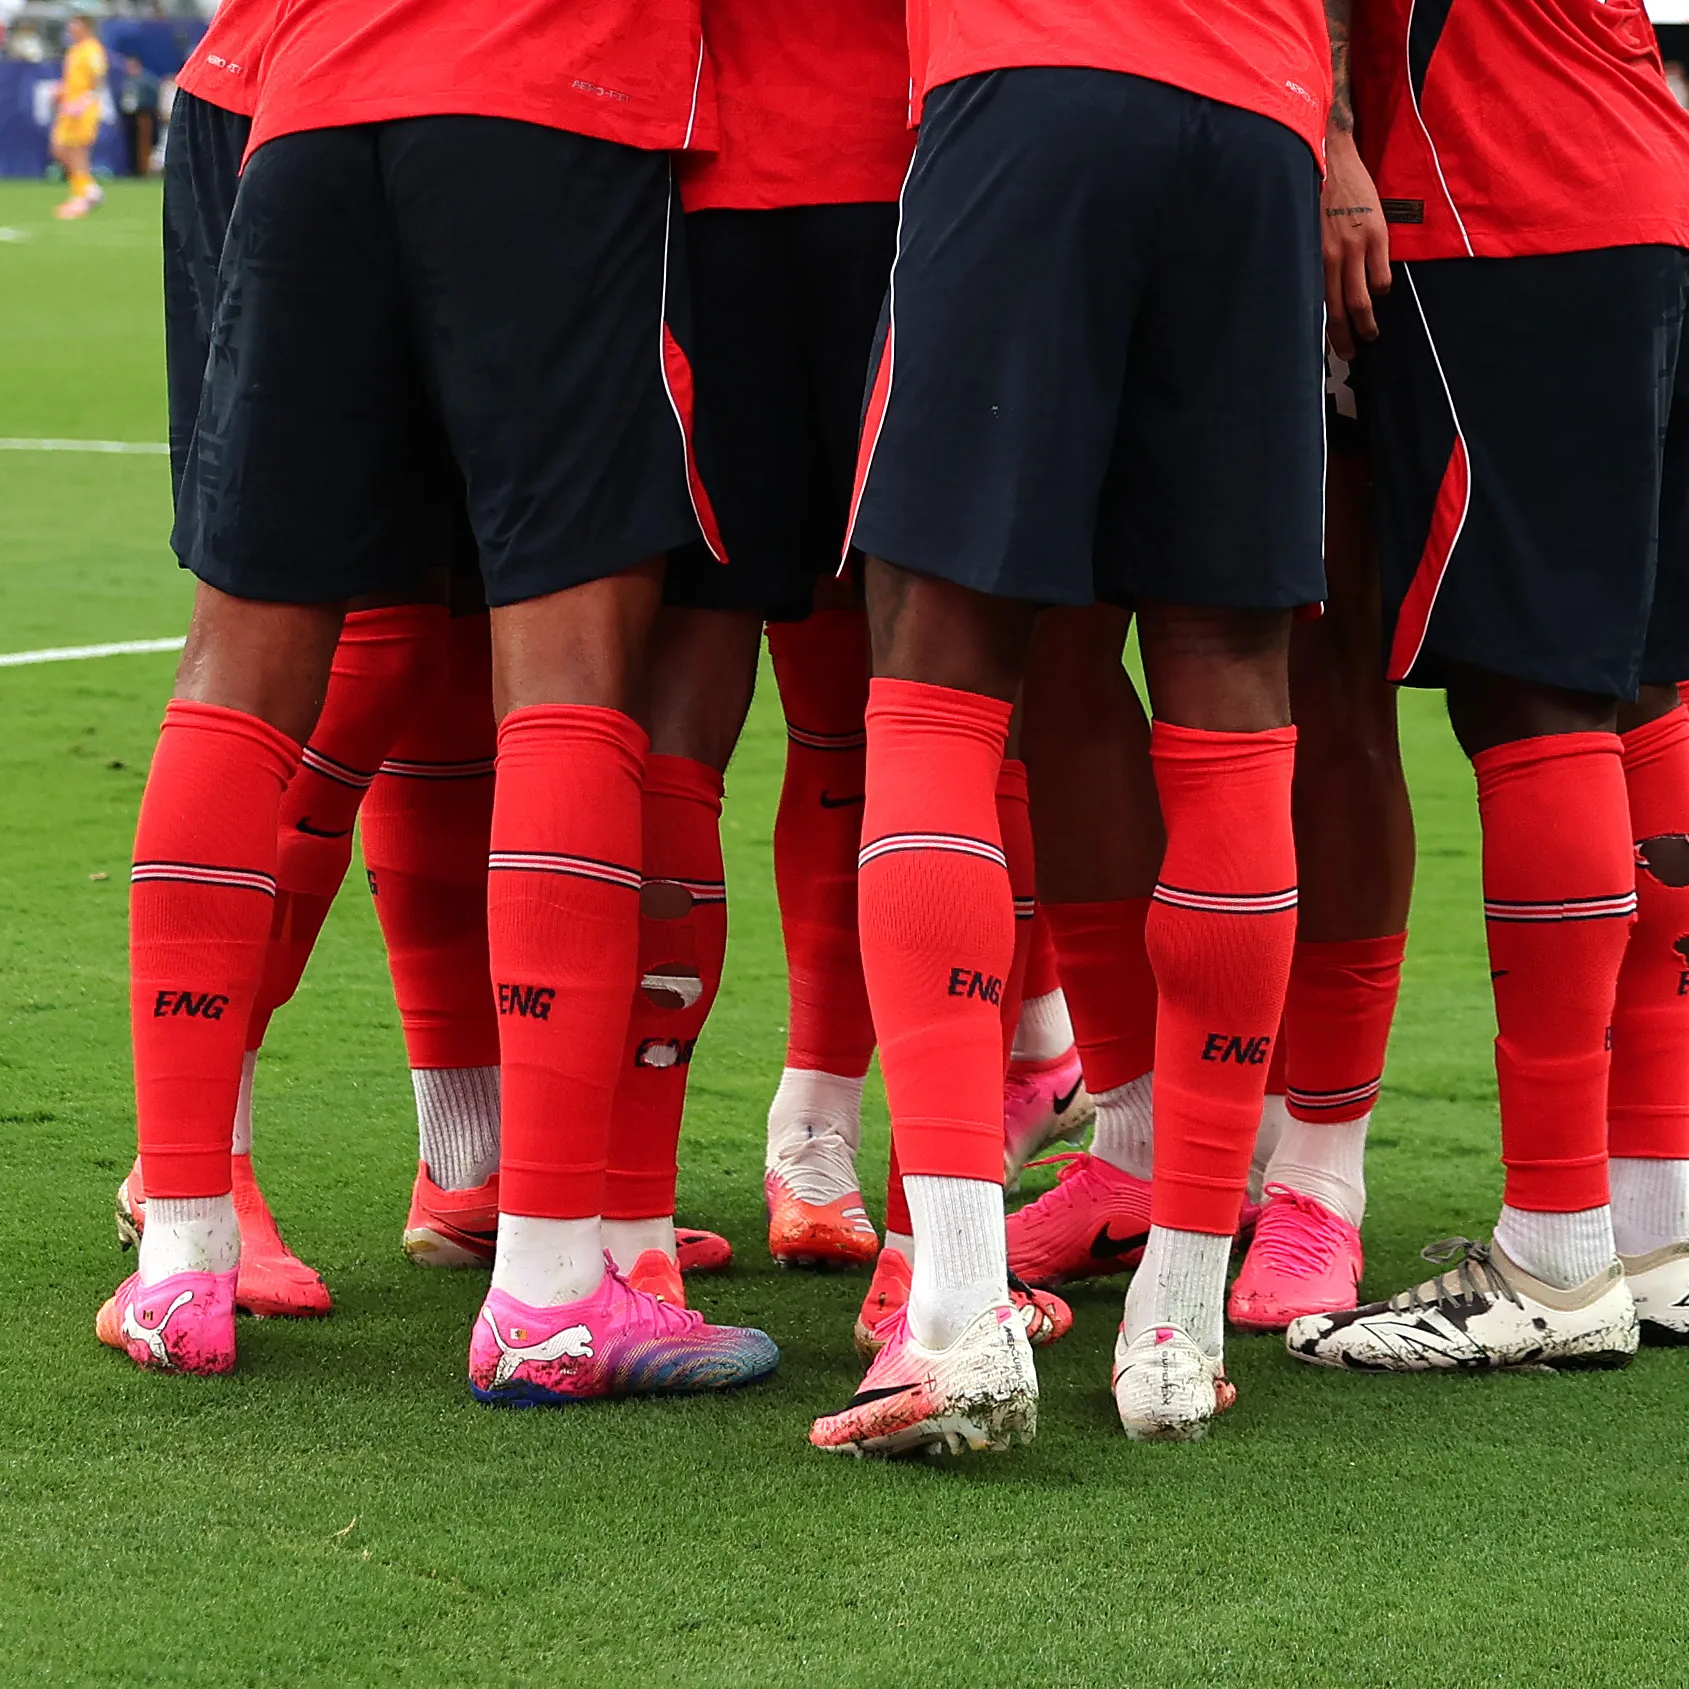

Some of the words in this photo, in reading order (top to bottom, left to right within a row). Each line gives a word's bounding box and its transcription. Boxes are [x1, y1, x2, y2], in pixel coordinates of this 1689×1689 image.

[497, 983, 555, 1021] ENG
[948, 968, 1002, 1007] ENG
[154, 990, 230, 1021] ENG
[1202, 1033, 1270, 1065] ENG
